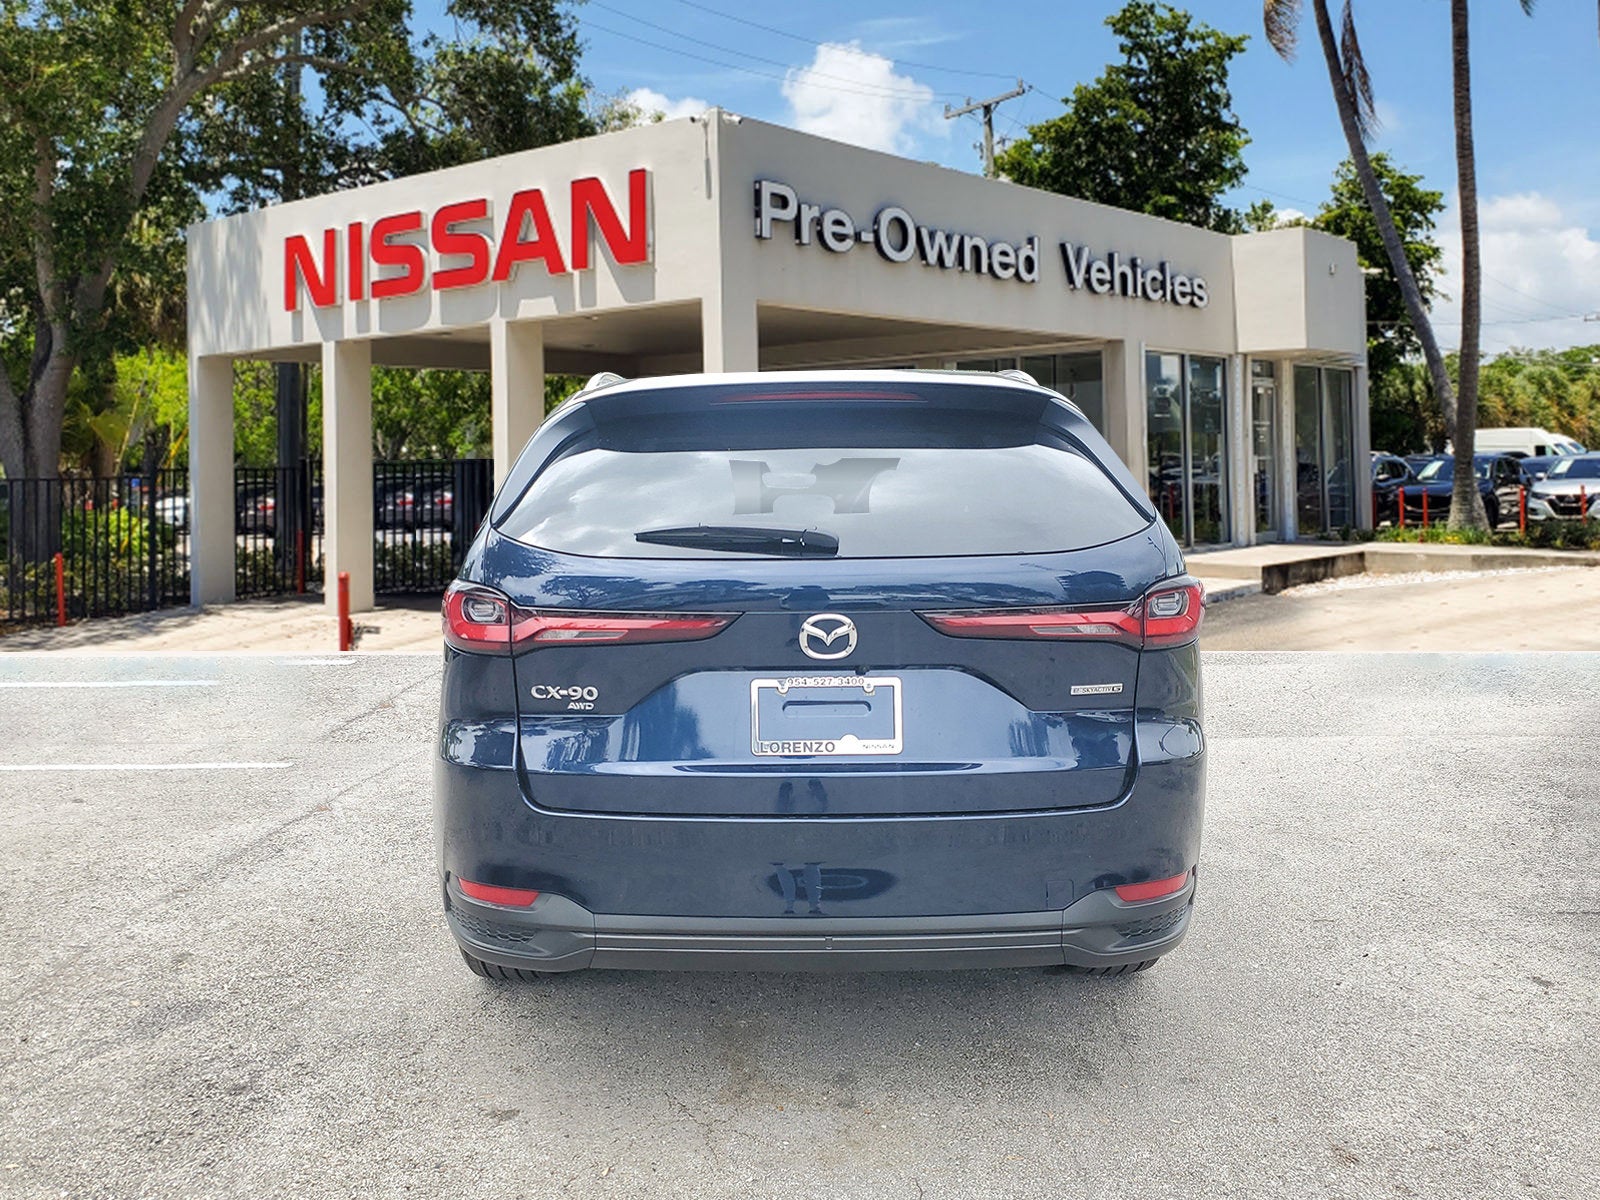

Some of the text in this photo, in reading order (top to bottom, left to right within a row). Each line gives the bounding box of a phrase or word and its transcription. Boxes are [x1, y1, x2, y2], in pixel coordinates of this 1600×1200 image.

[284, 167, 650, 312] NISSAN
[754, 180, 1209, 308] Pre-Owned Vehicles
[787, 677, 865, 686] 954-527-3400
[530, 684, 599, 701] CX-90
[567, 702, 595, 711] AWD
[760, 741, 836, 754] LORENZO
